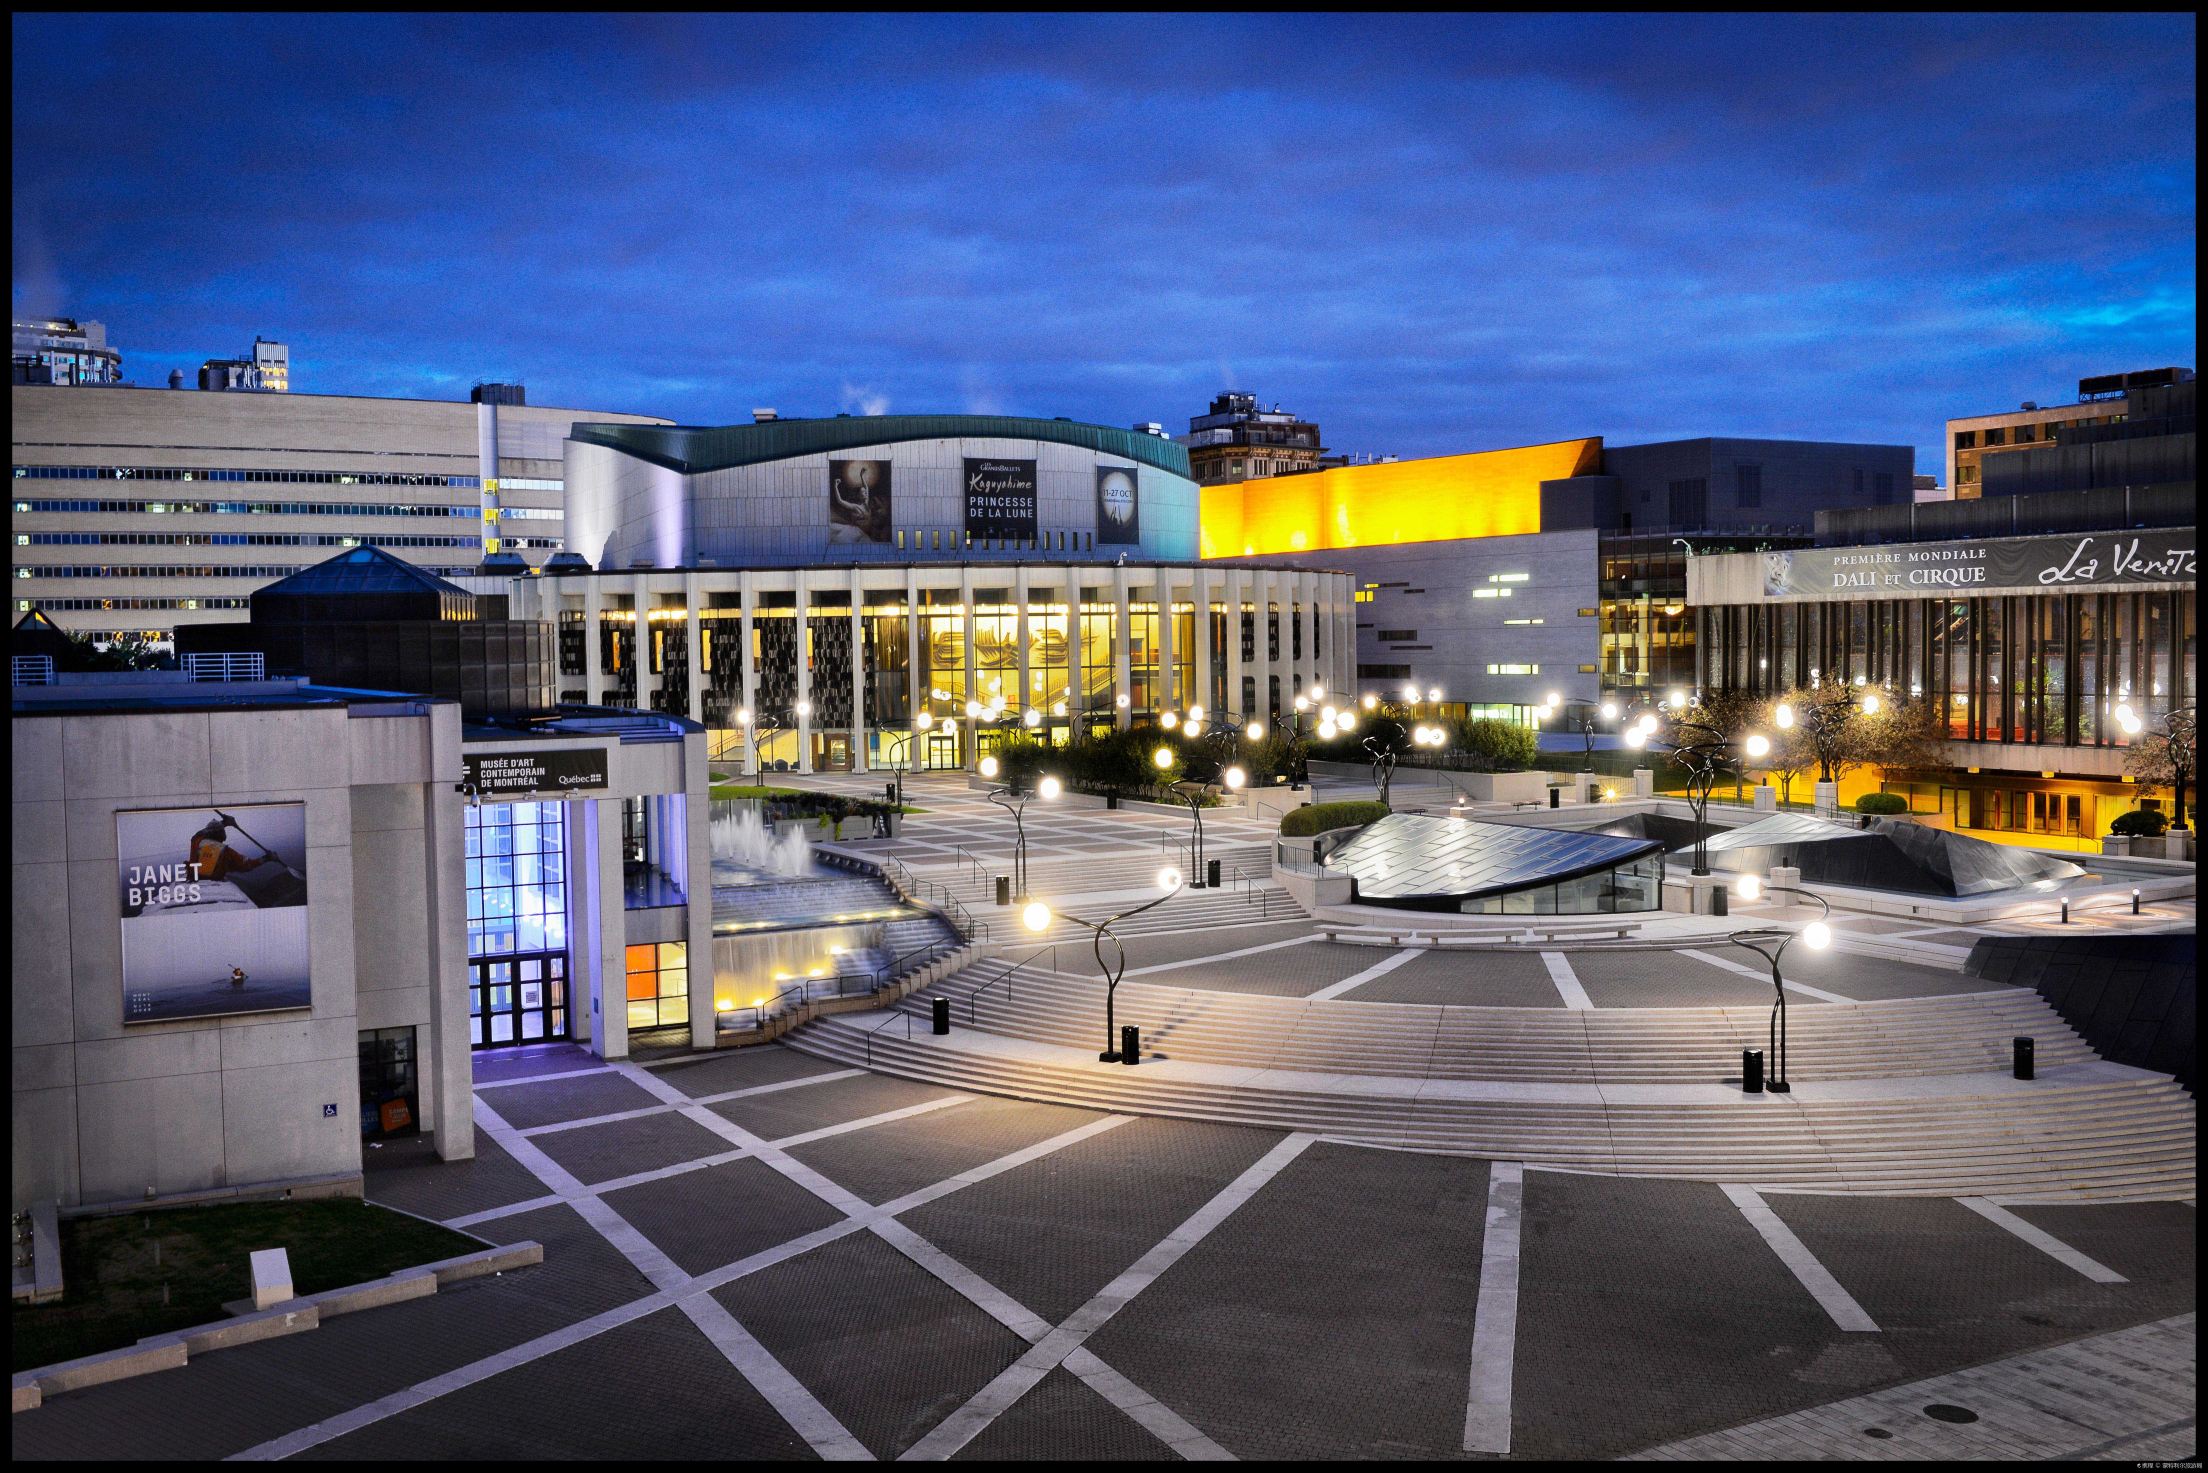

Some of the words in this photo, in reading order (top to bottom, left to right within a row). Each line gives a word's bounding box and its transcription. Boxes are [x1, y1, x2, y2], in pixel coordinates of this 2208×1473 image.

[969, 472, 1032, 493] Kaguyahime
[1119, 489, 1132, 497] OCT
[970, 497, 1033, 507] PRINCESSE
[970, 508, 983, 518] DE
[988, 509, 1001, 518] LA
[1006, 509, 1033, 518] LUNE
[1833, 552, 1901, 566] PREMIÈRE
[1908, 548, 1987, 562] MONDIALE
[2038, 537, 2098, 584] La
[1833, 571, 1876, 587] DALI
[1884, 574, 1901, 585] ET
[1909, 566, 1986, 587] CIRQUE
[480, 759, 508, 769] MUSÉE
[510, 758, 535, 767] D'ART
[480, 767, 545, 778] CONTEMPORAIN
[481, 778, 492, 788] DE
[494, 776, 539, 788] MONTRÉAL
[558, 774, 590, 784] Québec
[129, 862, 203, 885] JANET
[129, 884, 202, 906] BIGGS
